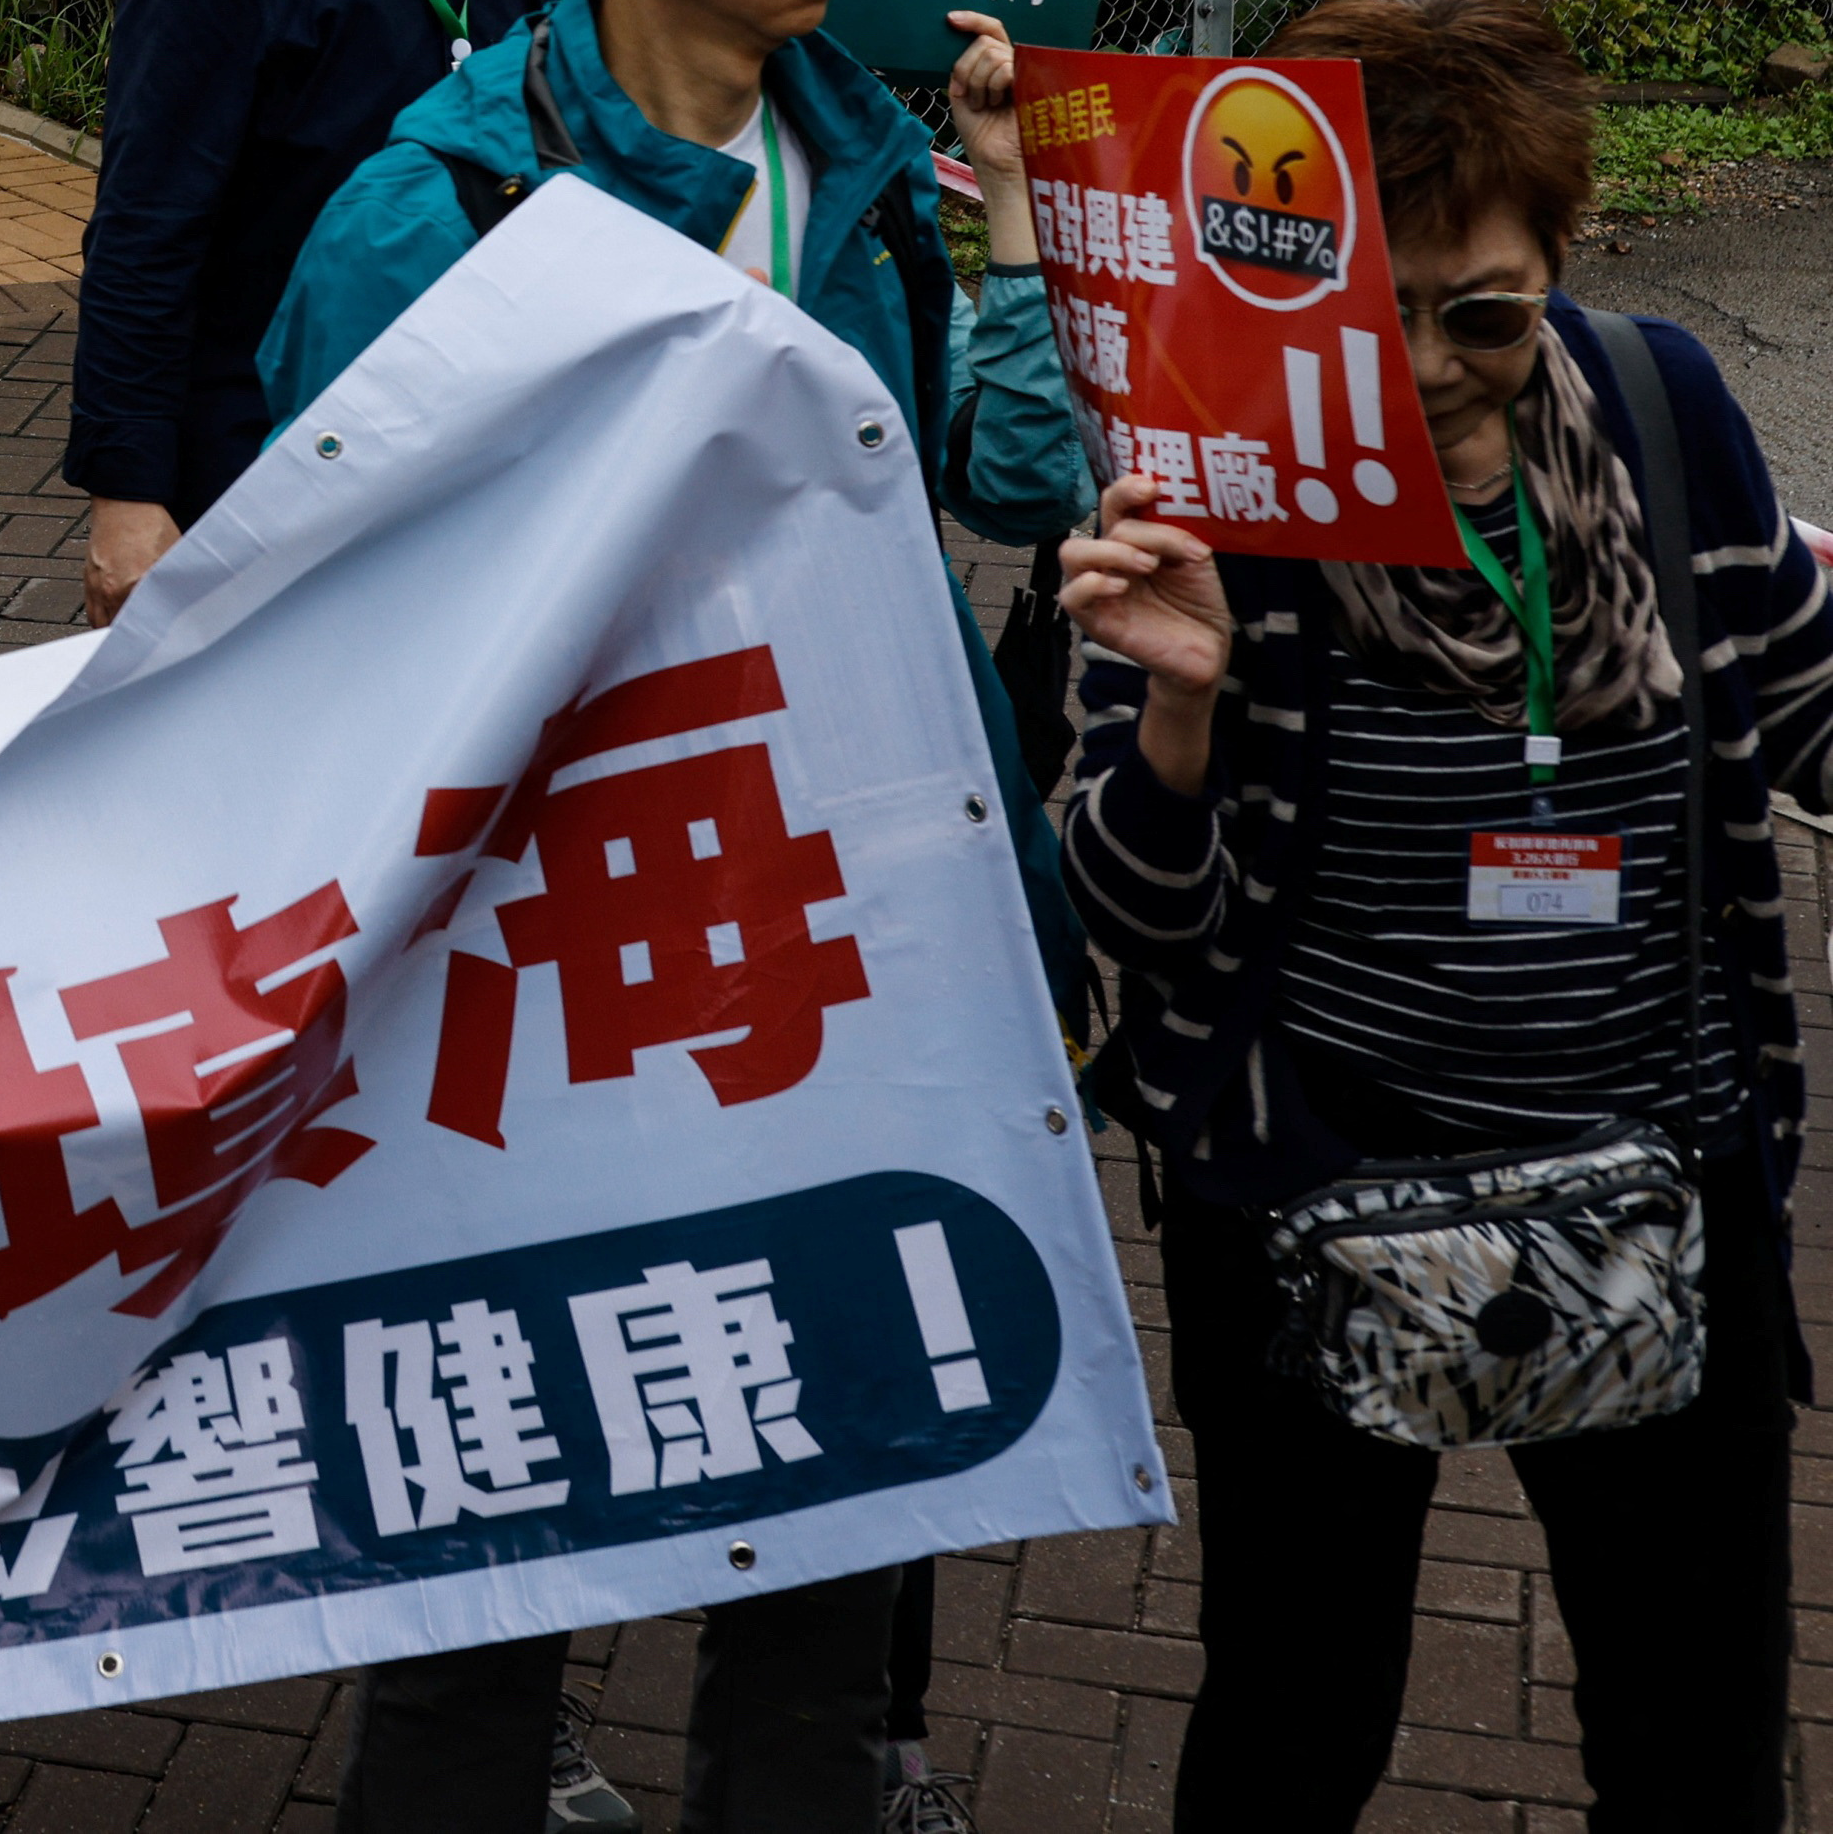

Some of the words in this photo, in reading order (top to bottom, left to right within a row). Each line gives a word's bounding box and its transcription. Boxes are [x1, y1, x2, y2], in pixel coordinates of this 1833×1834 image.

[1032, 177, 1178, 288] 反對興建
[1526, 891, 1564, 913] 074
